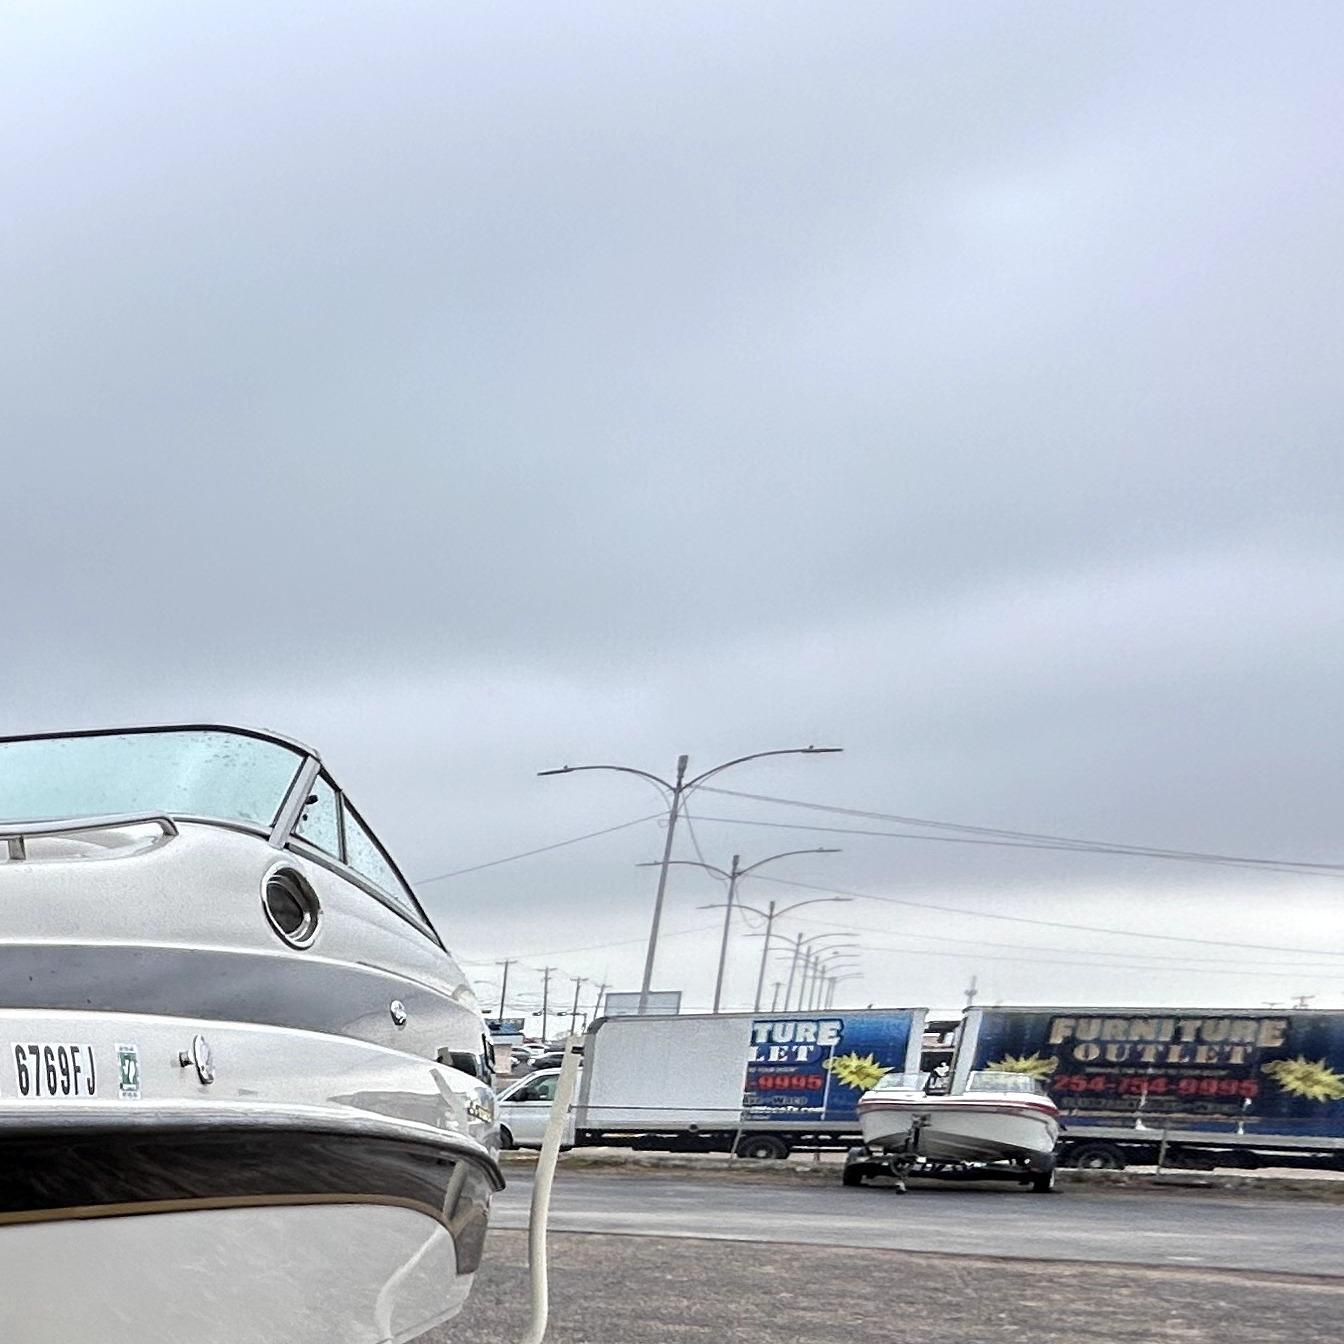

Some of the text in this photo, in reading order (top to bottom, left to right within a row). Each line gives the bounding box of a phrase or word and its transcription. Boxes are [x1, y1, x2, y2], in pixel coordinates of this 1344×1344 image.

[1048, 1018, 1288, 1047] FURNITURE
[1073, 1043, 1253, 1064] OUTLET
[15, 1045, 95, 1096] 6769FJ
